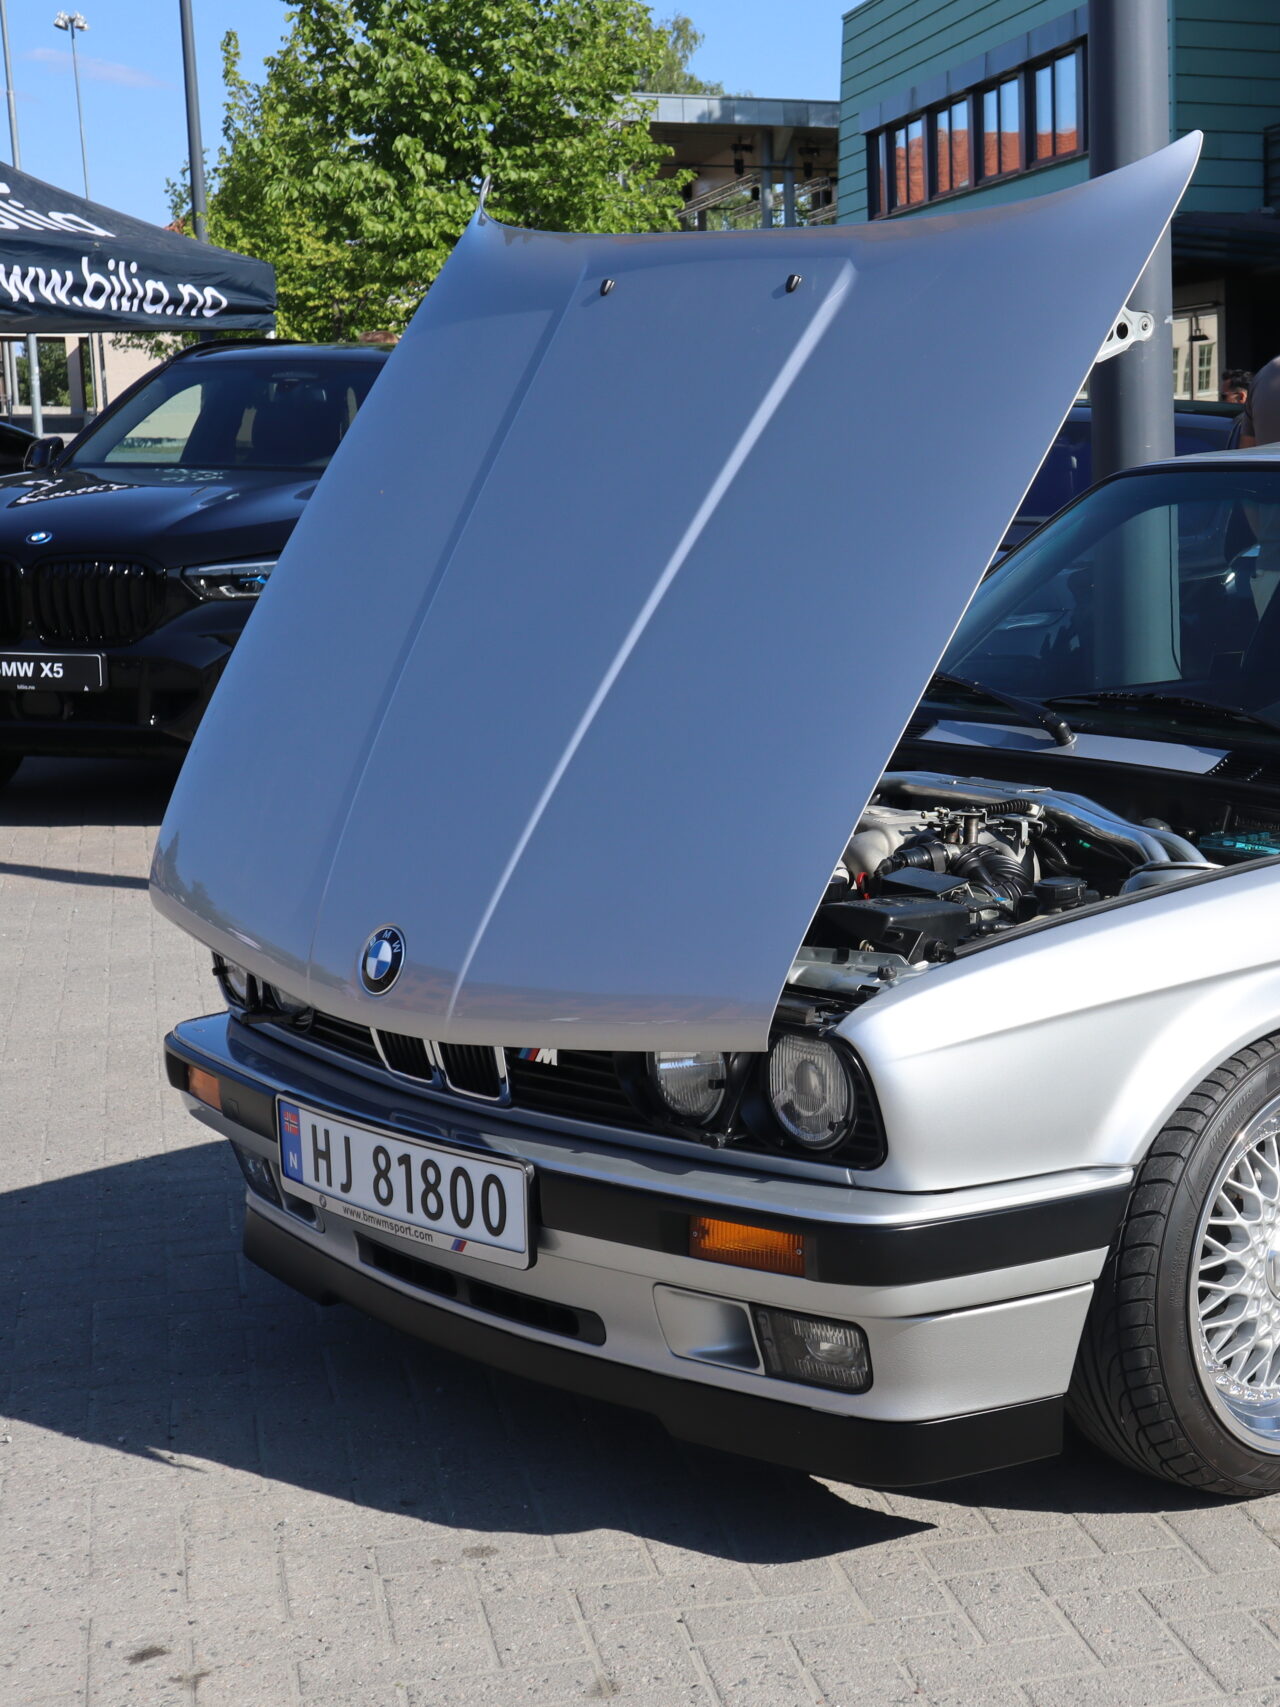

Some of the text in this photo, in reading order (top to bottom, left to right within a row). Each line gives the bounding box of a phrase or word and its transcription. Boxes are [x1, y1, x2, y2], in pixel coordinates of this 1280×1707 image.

[0, 661, 64, 678] MW X5
[288, 1151, 298, 1170] N
[311, 1124, 507, 1237] HJ 81800
[342, 1205, 434, 1243] www.bmwmsport.com
